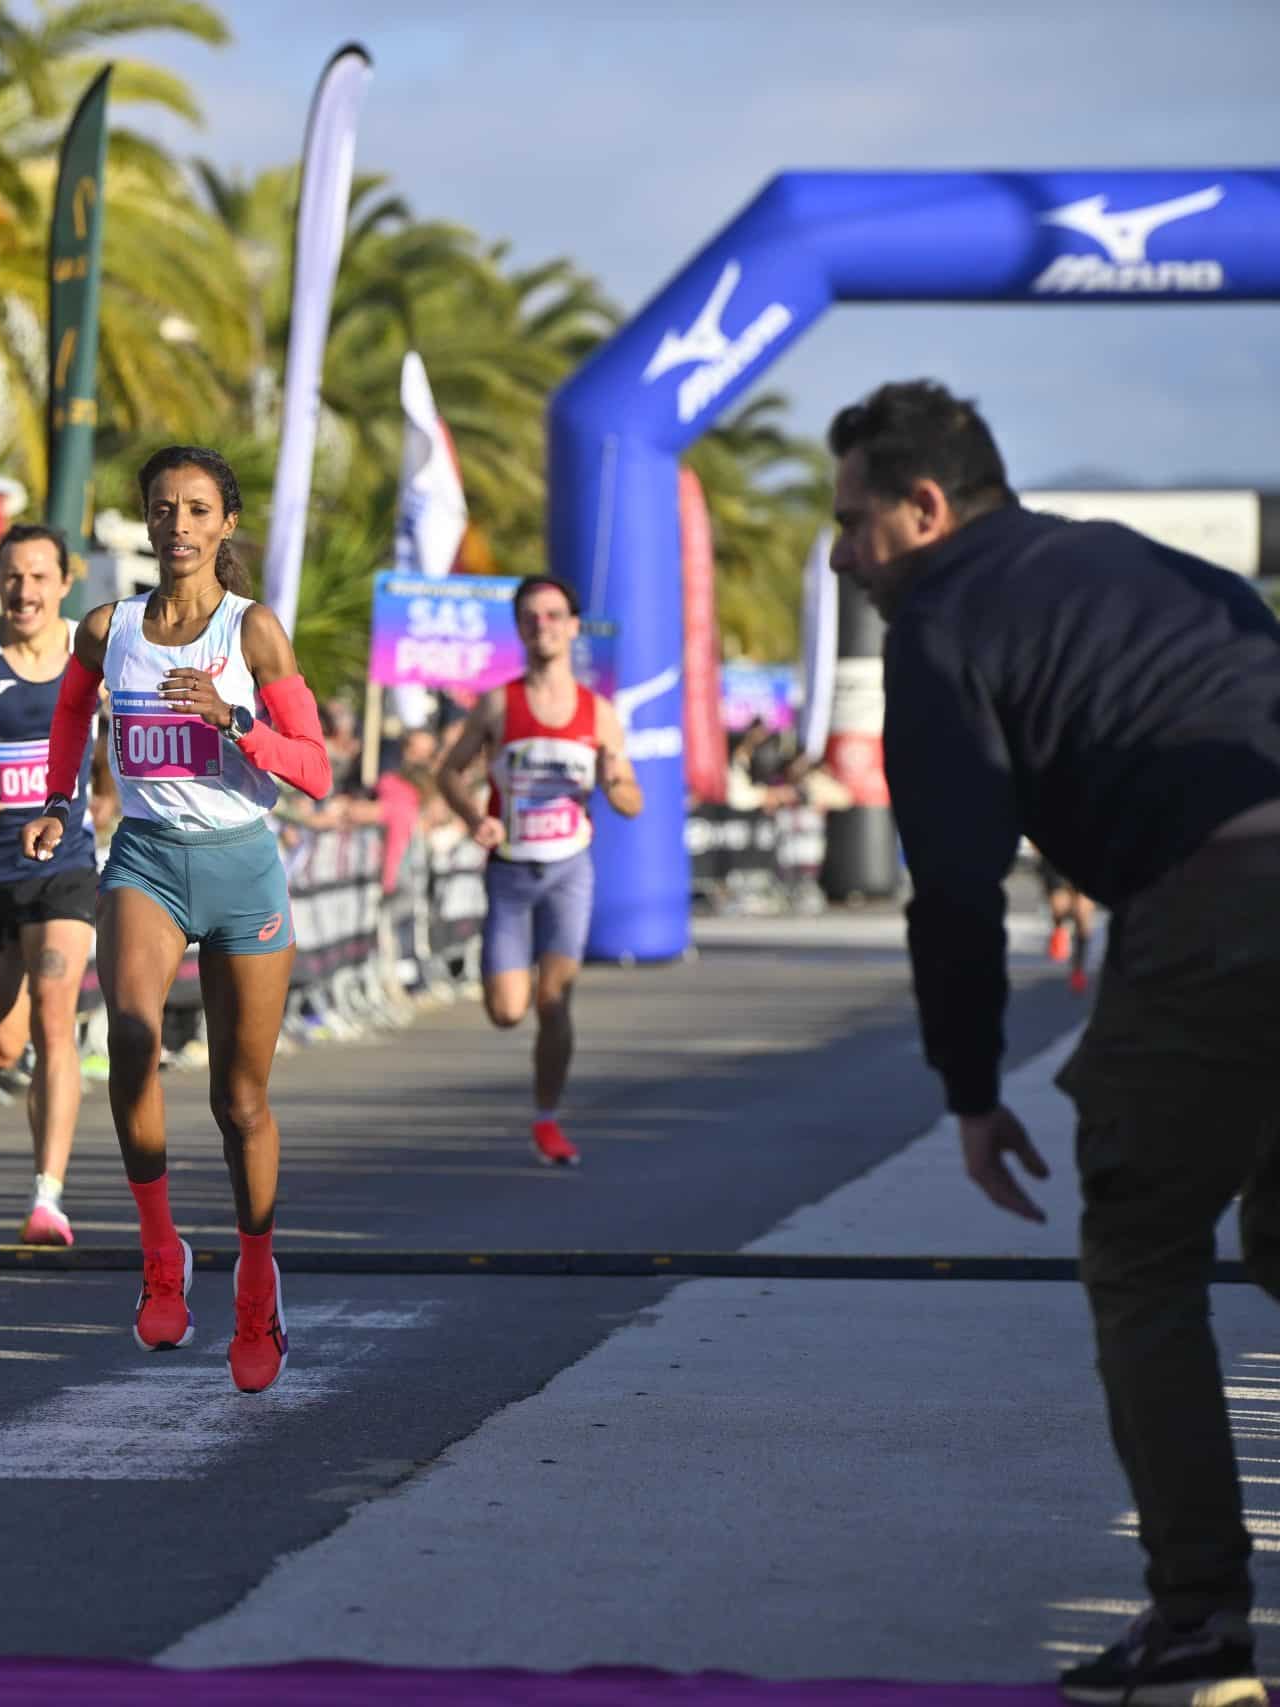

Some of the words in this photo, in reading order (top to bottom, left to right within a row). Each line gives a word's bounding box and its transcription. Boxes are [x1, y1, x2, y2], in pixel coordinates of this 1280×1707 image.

[406, 599, 488, 640] SAS
[128, 724, 192, 765] 0011
[2, 765, 49, 797] 014
